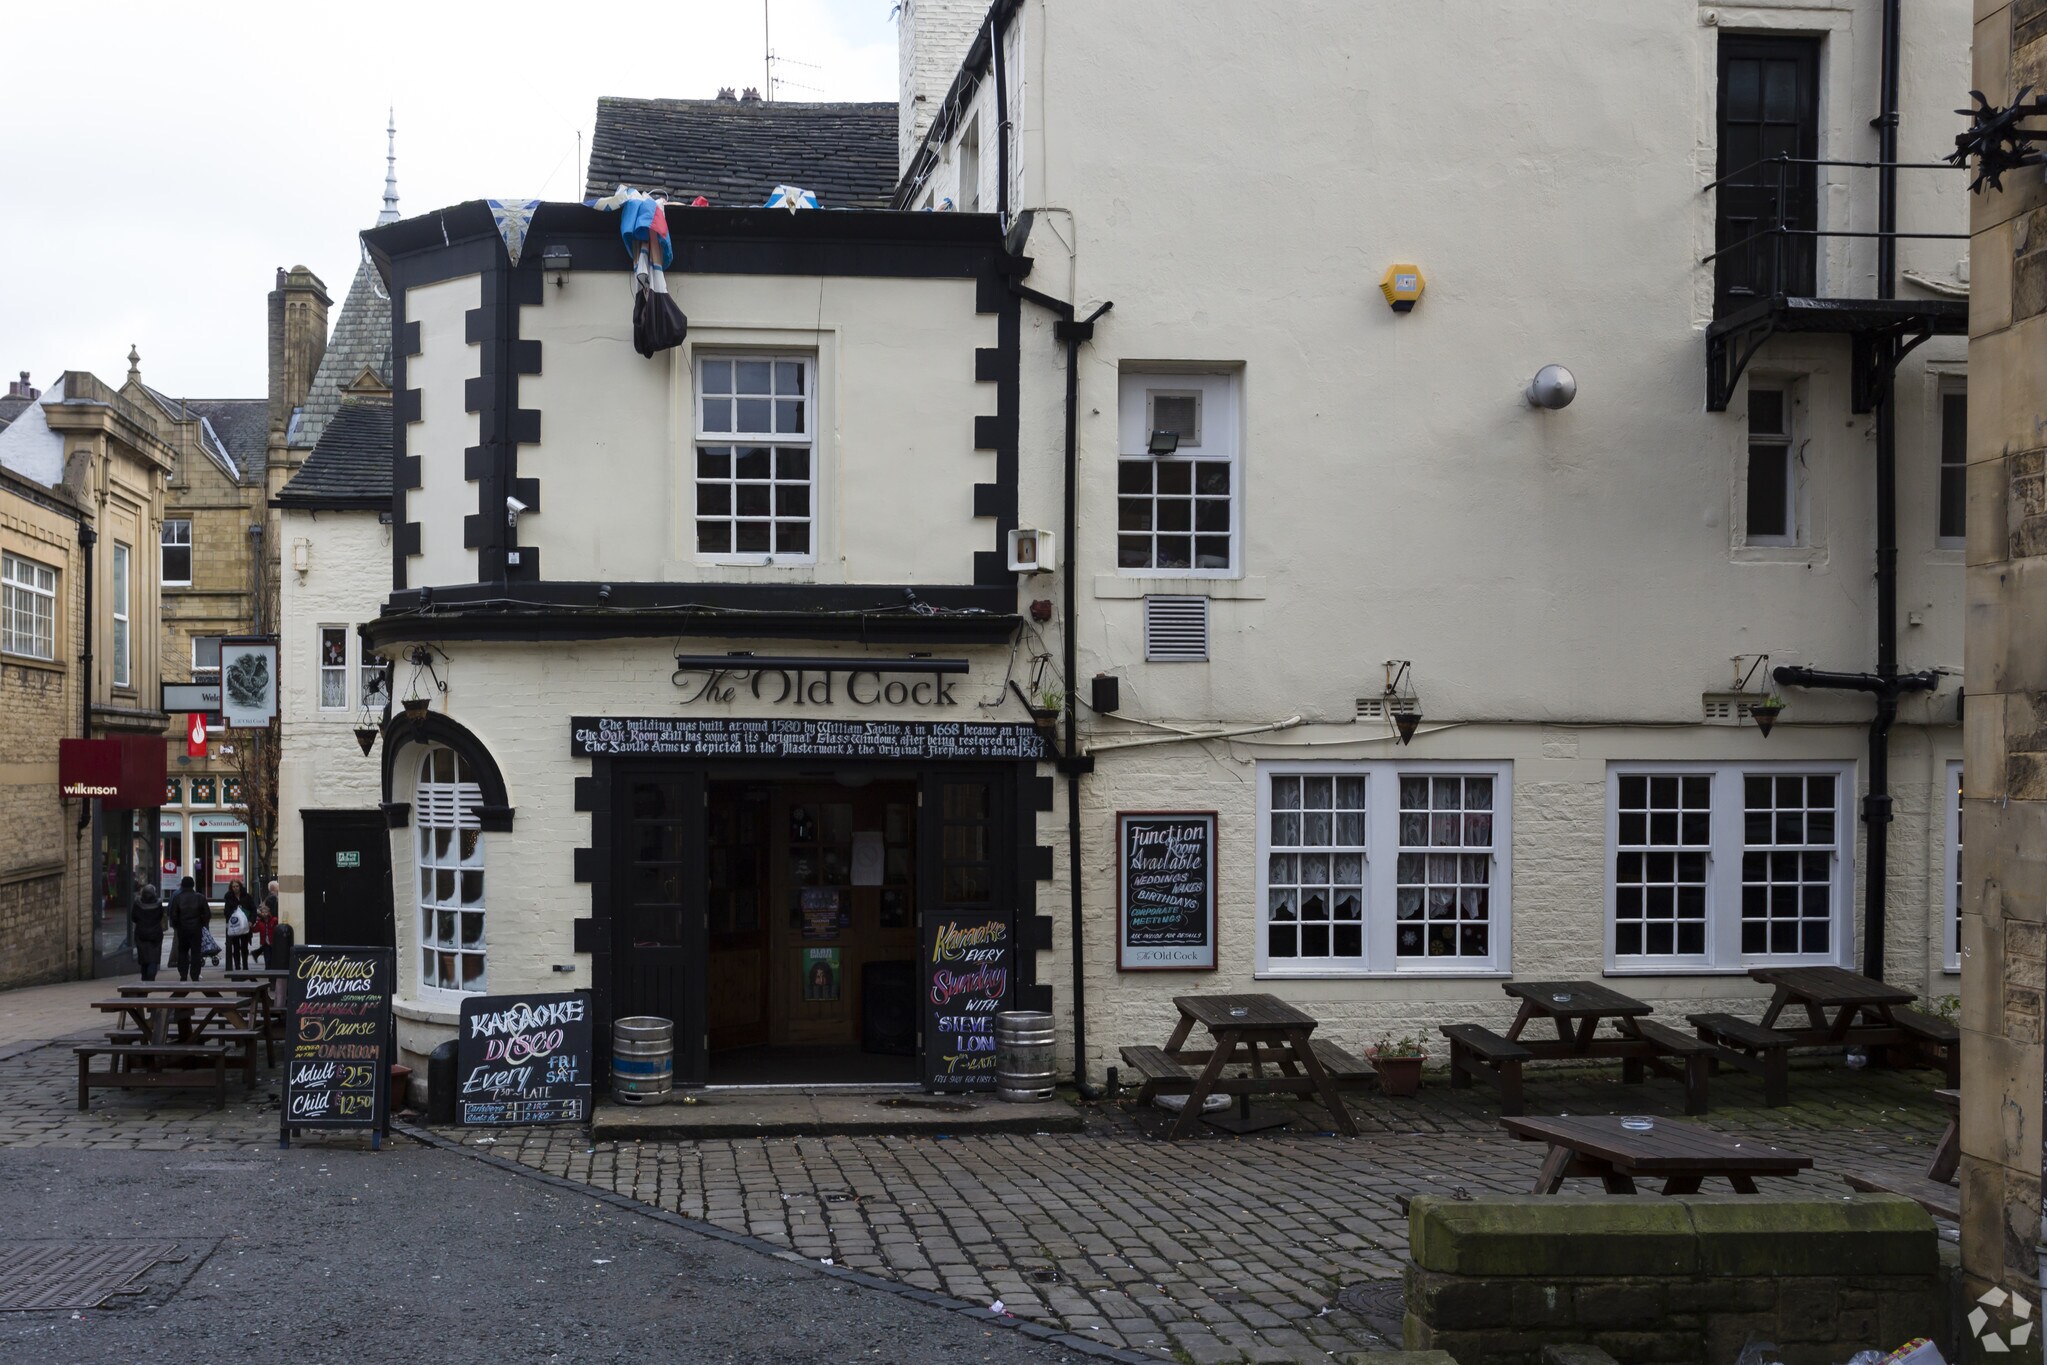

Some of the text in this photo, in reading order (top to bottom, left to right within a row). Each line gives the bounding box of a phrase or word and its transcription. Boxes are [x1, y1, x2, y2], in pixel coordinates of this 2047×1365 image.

[672, 668, 958, 704] The Old Cock
[599, 719, 623, 731] The
[626, 719, 672, 732] building
[676, 722, 697, 731] was
[699, 720, 724, 732] built
[729, 721, 768, 732] around
[771, 720, 801, 733] 1580
[803, 722, 816, 736] by
[817, 721, 862, 734] William
[904, 725, 911, 735] &
[915, 724, 926, 735] in
[933, 723, 960, 735] 1668
[963, 724, 997, 736] became
[1000, 726, 1012, 737] an
[575, 729, 598, 742] The
[660, 731, 684, 740] still
[686, 731, 701, 742] has
[704, 733, 730, 743] some
[730, 732, 742, 744] of
[744, 731, 759, 743] its
[816, 734, 850, 744] Glass
[900, 734, 926, 747] after
[927, 735, 955, 747] being
[959, 735, 1004, 747] restored
[1006, 736, 1017, 747] in
[584, 741, 607, 752] The
[608, 741, 650, 753] Saville
[651, 741, 679, 752] Arms
[680, 743, 691, 752] is
[695, 741, 741, 756] depicted
[744, 743, 757, 753] in
[760, 742, 777, 753] the
[846, 744, 854, 754] &
[858, 745, 875, 755] the
[981, 745, 989, 755] is
[992, 746, 1018, 756] dated
[63, 782, 118, 795] wilkinson
[208, 819, 240, 827] Santander
[1130, 825, 1205, 856] Function
[1165, 836, 1201, 858] Room
[1131, 848, 1202, 870] Available
[1134, 872, 1190, 886] WEDDINGS
[1172, 882, 1203, 895] WAKES
[1137, 890, 1199, 909] BIRTHDAYS
[1131, 906, 1180, 917] CORPORATE
[1132, 914, 1182, 926] MEETINGS
[932, 920, 1007, 964] Karaoke
[965, 949, 1005, 963] EVERY
[1136, 951, 1198, 961] The Old Cock
[296, 954, 378, 980] Christmas
[306, 975, 371, 999] Bookings
[930, 963, 1008, 1005] Sunday
[296, 1001, 358, 1016] DECEMBER
[965, 1000, 999, 1012] WITH
[470, 999, 584, 1039] KARAOKE
[298, 1016, 376, 1042] 5 Course
[483, 1028, 564, 1061] DISCO
[547, 1054, 578, 1069] FRI
[291, 1062, 336, 1085] Adult
[462, 1065, 534, 1094] Every
[546, 1069, 579, 1083] SAT
[523, 1086, 552, 1099] LATE
[292, 1090, 330, 1114] Child
